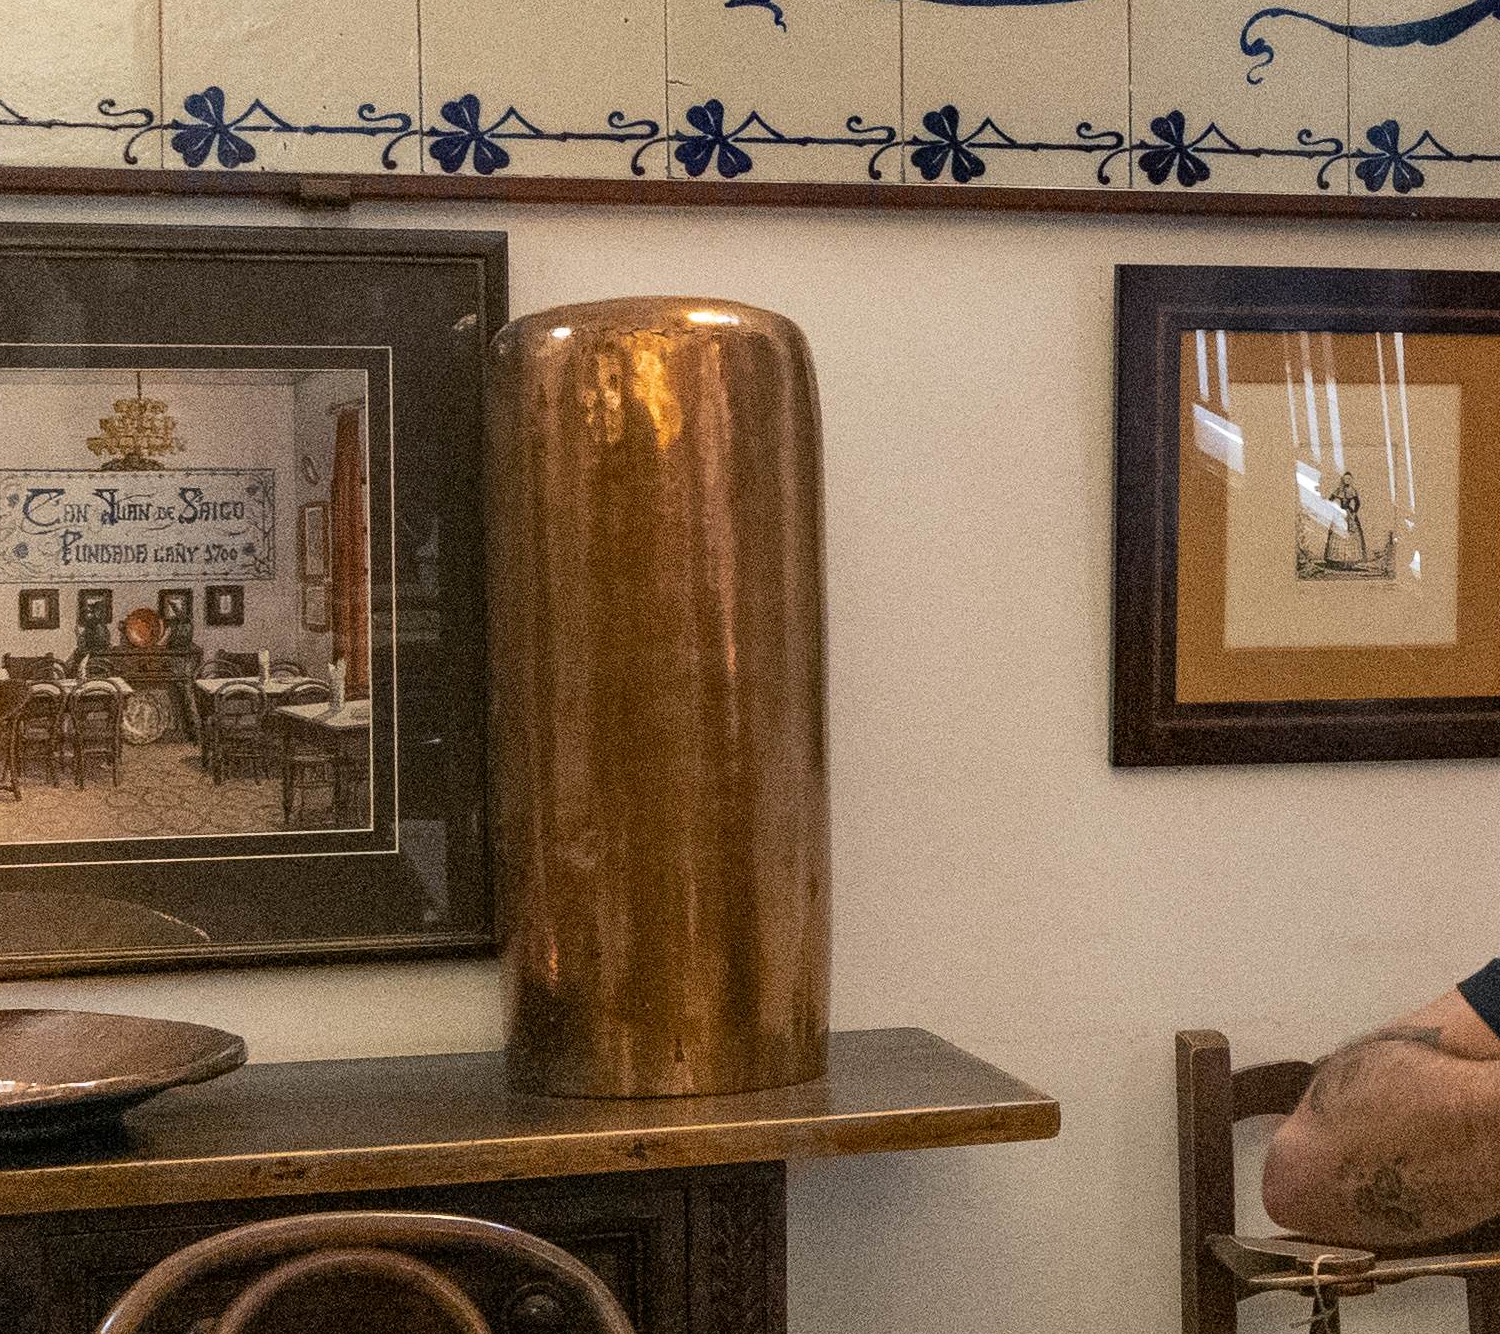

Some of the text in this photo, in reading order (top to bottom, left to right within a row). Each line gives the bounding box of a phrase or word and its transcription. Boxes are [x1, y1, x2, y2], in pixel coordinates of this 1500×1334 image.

[22, 488, 91, 527] CAN
[93, 488, 151, 525] JUAN
[156, 506, 176, 519] DE
